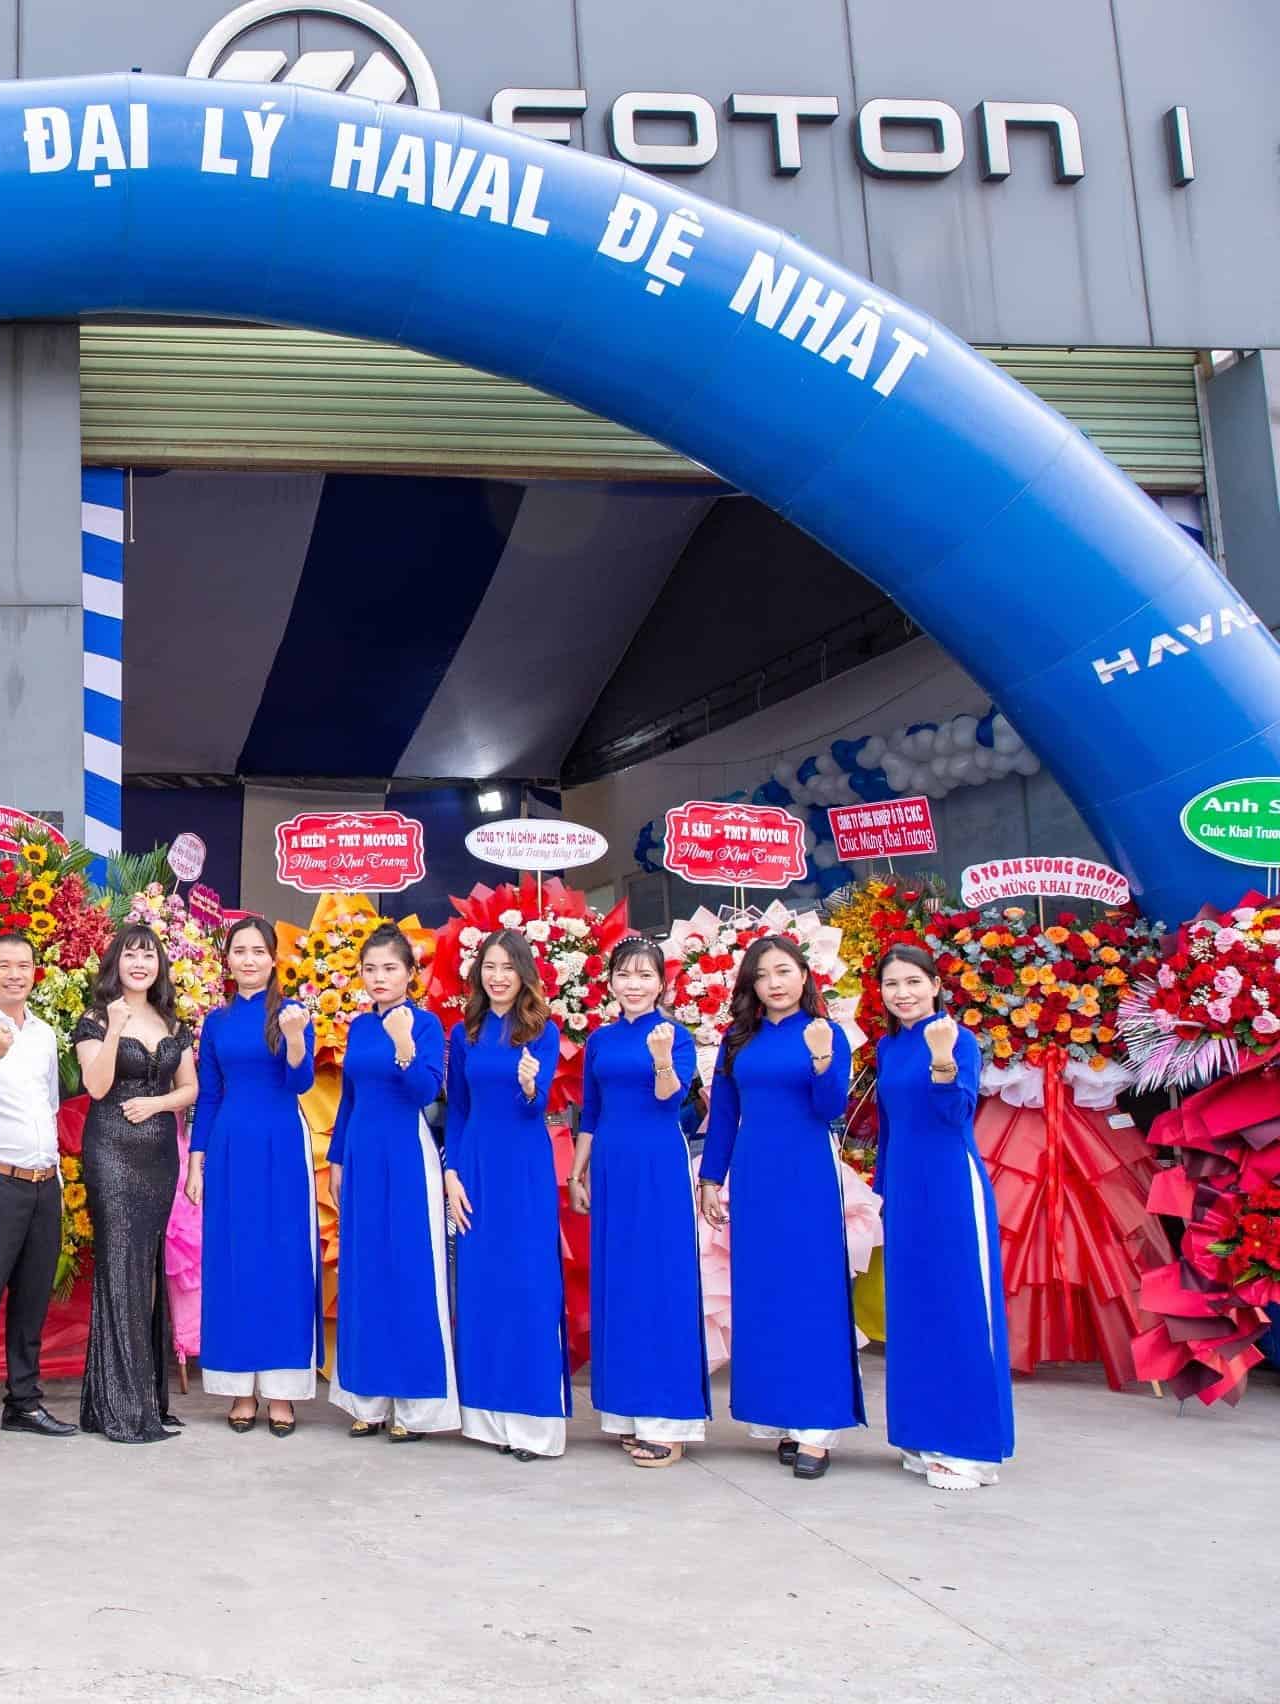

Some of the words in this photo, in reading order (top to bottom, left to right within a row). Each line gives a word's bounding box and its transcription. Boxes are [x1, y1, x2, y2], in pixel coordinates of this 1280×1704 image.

[22, 102, 150, 189] ĐẠI
[199, 101, 288, 180] LÝ
[328, 122, 551, 237] HAVAL
[596, 192, 706, 297] ĐỆ
[727, 248, 930, 398] NHẤT
[903, 804, 924, 823] CKC
[1202, 796, 1259, 814] Anh
[680, 821, 690, 837] A
[723, 825, 748, 841] TMT
[750, 827, 790, 845] MOTOR
[1228, 824, 1253, 838] Khai
[290, 834, 300, 849] A
[337, 833, 361, 848] TMT
[362, 833, 408, 848] MOTORS
[1076, 862, 1128, 889] GROUP
[1039, 879, 1072, 895] KHAI
